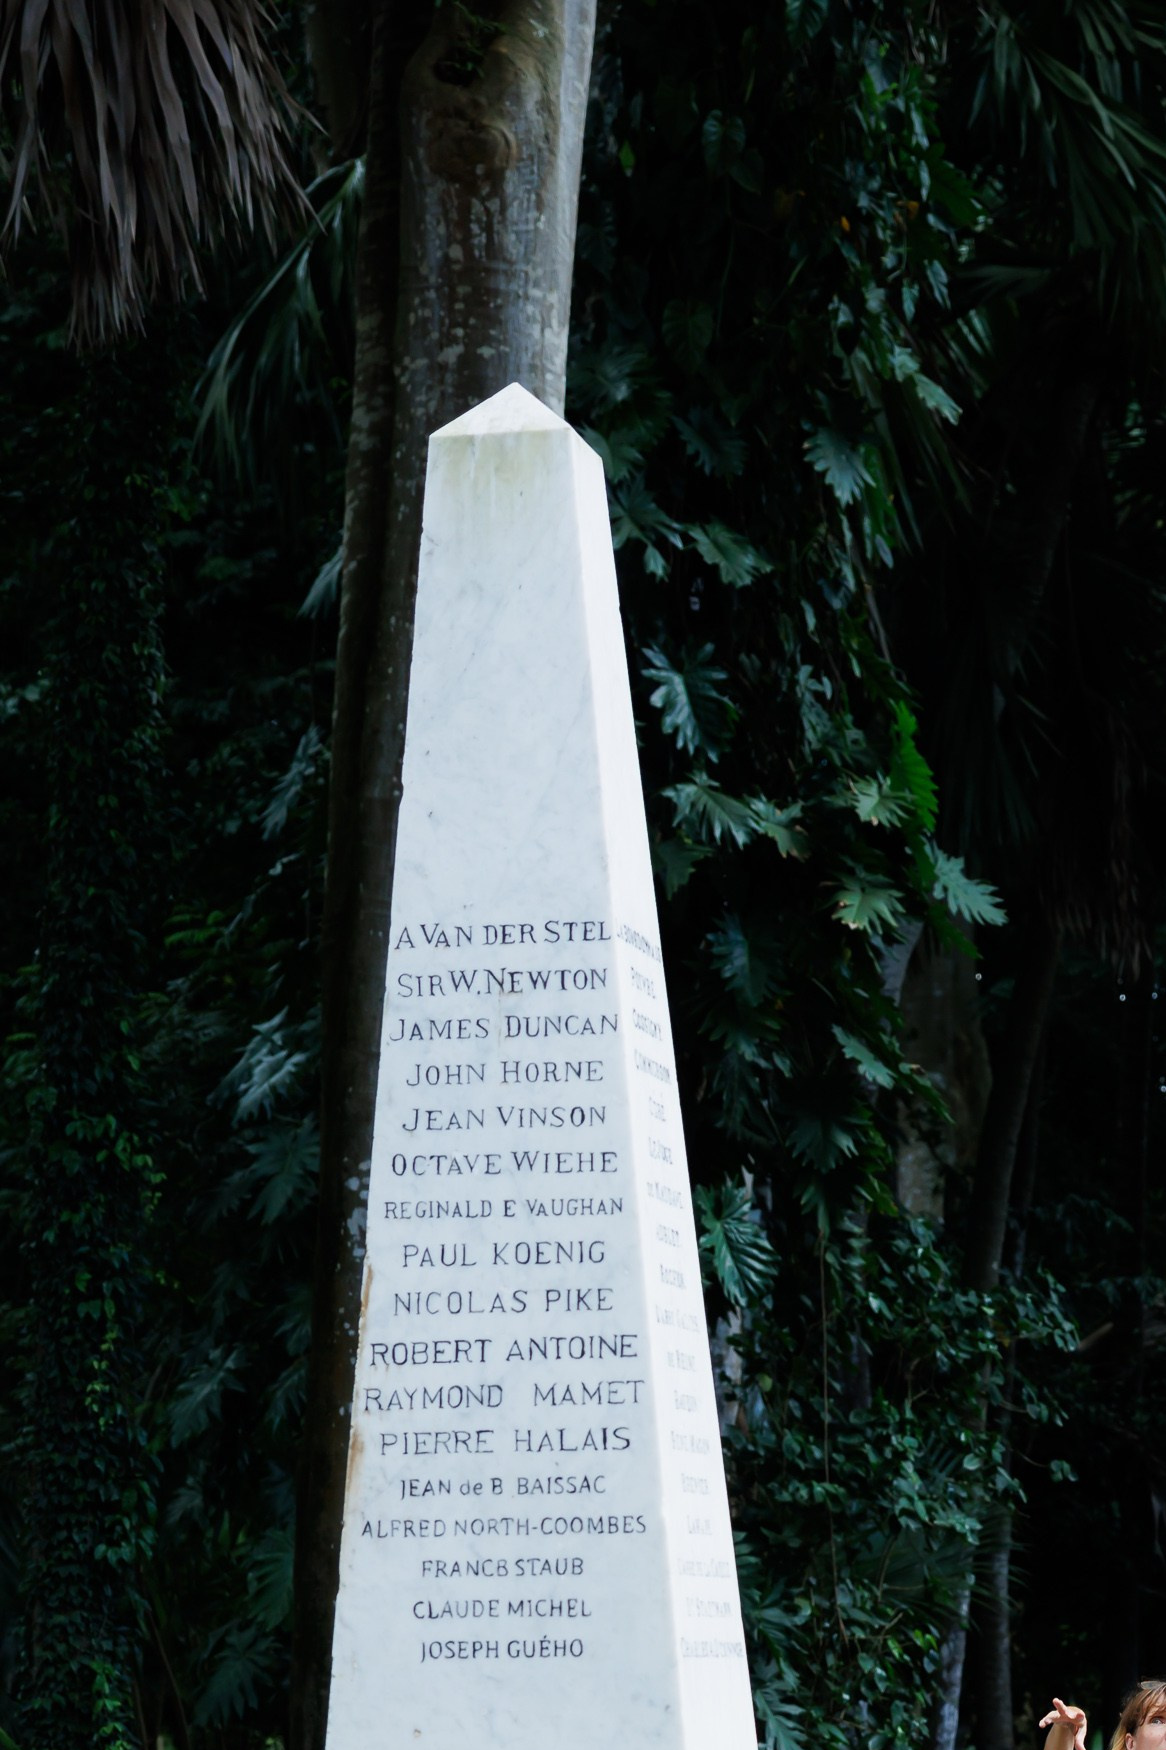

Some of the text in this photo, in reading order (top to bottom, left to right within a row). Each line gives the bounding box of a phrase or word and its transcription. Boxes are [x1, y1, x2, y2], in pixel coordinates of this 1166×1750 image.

[394, 926, 415, 950] A
[420, 922, 473, 948] VAN
[482, 923, 537, 945] DER
[544, 920, 611, 944] STEL
[397, 973, 446, 998] SIR
[483, 967, 608, 995] NEWTON
[389, 1017, 490, 1042] JAMES
[505, 1013, 619, 1038] DUNCAN
[406, 1060, 604, 1087] JOHN HORNE
[402, 1106, 606, 1132] JEAN VINSON
[392, 1150, 618, 1176] OCTAVE WIEHE
[384, 1198, 623, 1219] REGINALD E VAUGHAN
[403, 1240, 605, 1267] PAUL KOENIG
[394, 1288, 614, 1316] NICOLAS PIKE
[369, 1339, 492, 1366] ROBERT
[506, 1335, 638, 1362] ANTOINE
[363, 1384, 504, 1411] RAYMOND
[533, 1380, 645, 1407] MAMET
[380, 1427, 631, 1456] PIERRE HALAIS
[400, 1475, 606, 1500] JEAN de B BAISSAC
[361, 1515, 647, 1538] ALFRED NORTH-COOMBES
[515, 1558, 584, 1577] STAUB
[413, 1598, 592, 1619] CLAUDE MICHEL
[420, 1635, 584, 1663] JOSEPH GUÉHO
